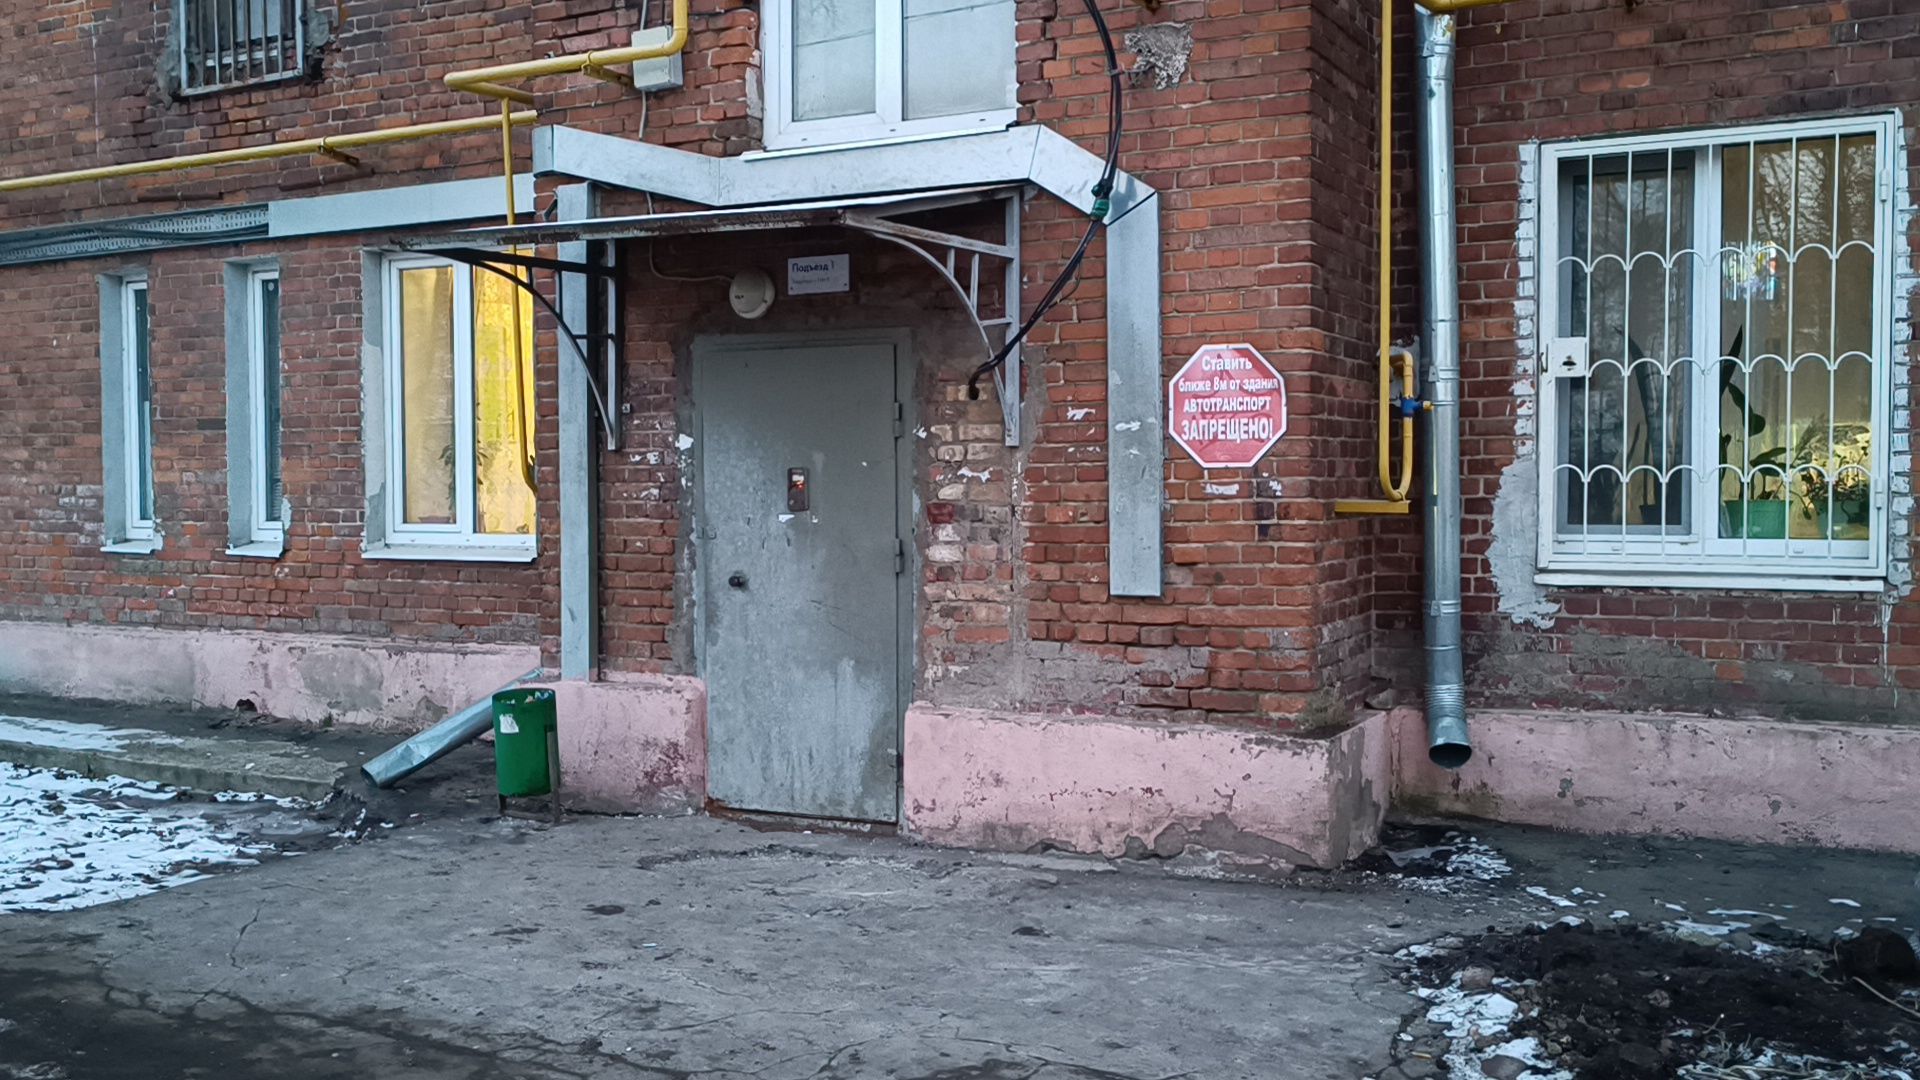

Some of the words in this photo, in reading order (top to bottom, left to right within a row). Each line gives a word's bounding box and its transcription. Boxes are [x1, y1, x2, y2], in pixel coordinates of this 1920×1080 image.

[792, 262, 829, 272] Подъезд
[1202, 355, 1253, 371] Ставить
[1178, 378, 1211, 392] ближе
[1229, 379, 1241, 390] от
[1243, 378, 1279, 391] здания
[1183, 396, 1272, 413] АВТОТРАНСПОРТ
[1181, 418, 1274, 443] ЗАПРЕЩЕНО!
